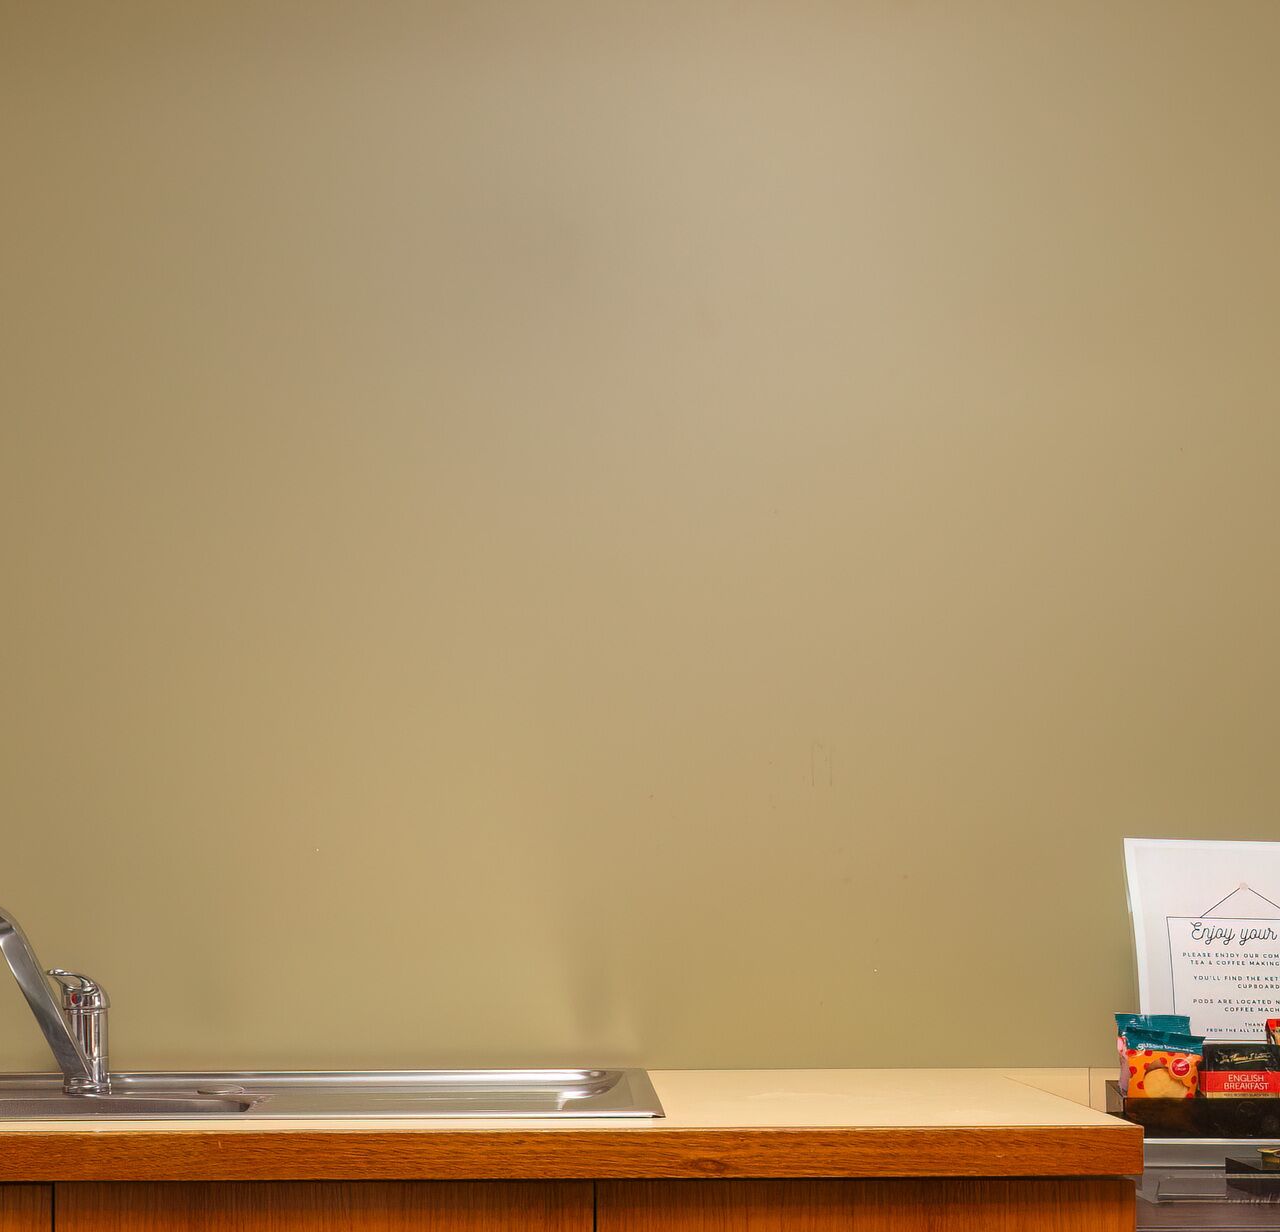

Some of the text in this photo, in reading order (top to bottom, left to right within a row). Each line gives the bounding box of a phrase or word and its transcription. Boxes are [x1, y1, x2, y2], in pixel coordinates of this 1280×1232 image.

[1191, 921, 1235, 946] Enjoy
[1239, 926, 1277, 947] your
[1228, 1074, 1264, 1082] ENGLISH
[1223, 1082, 1269, 1091] BREAKFAST
